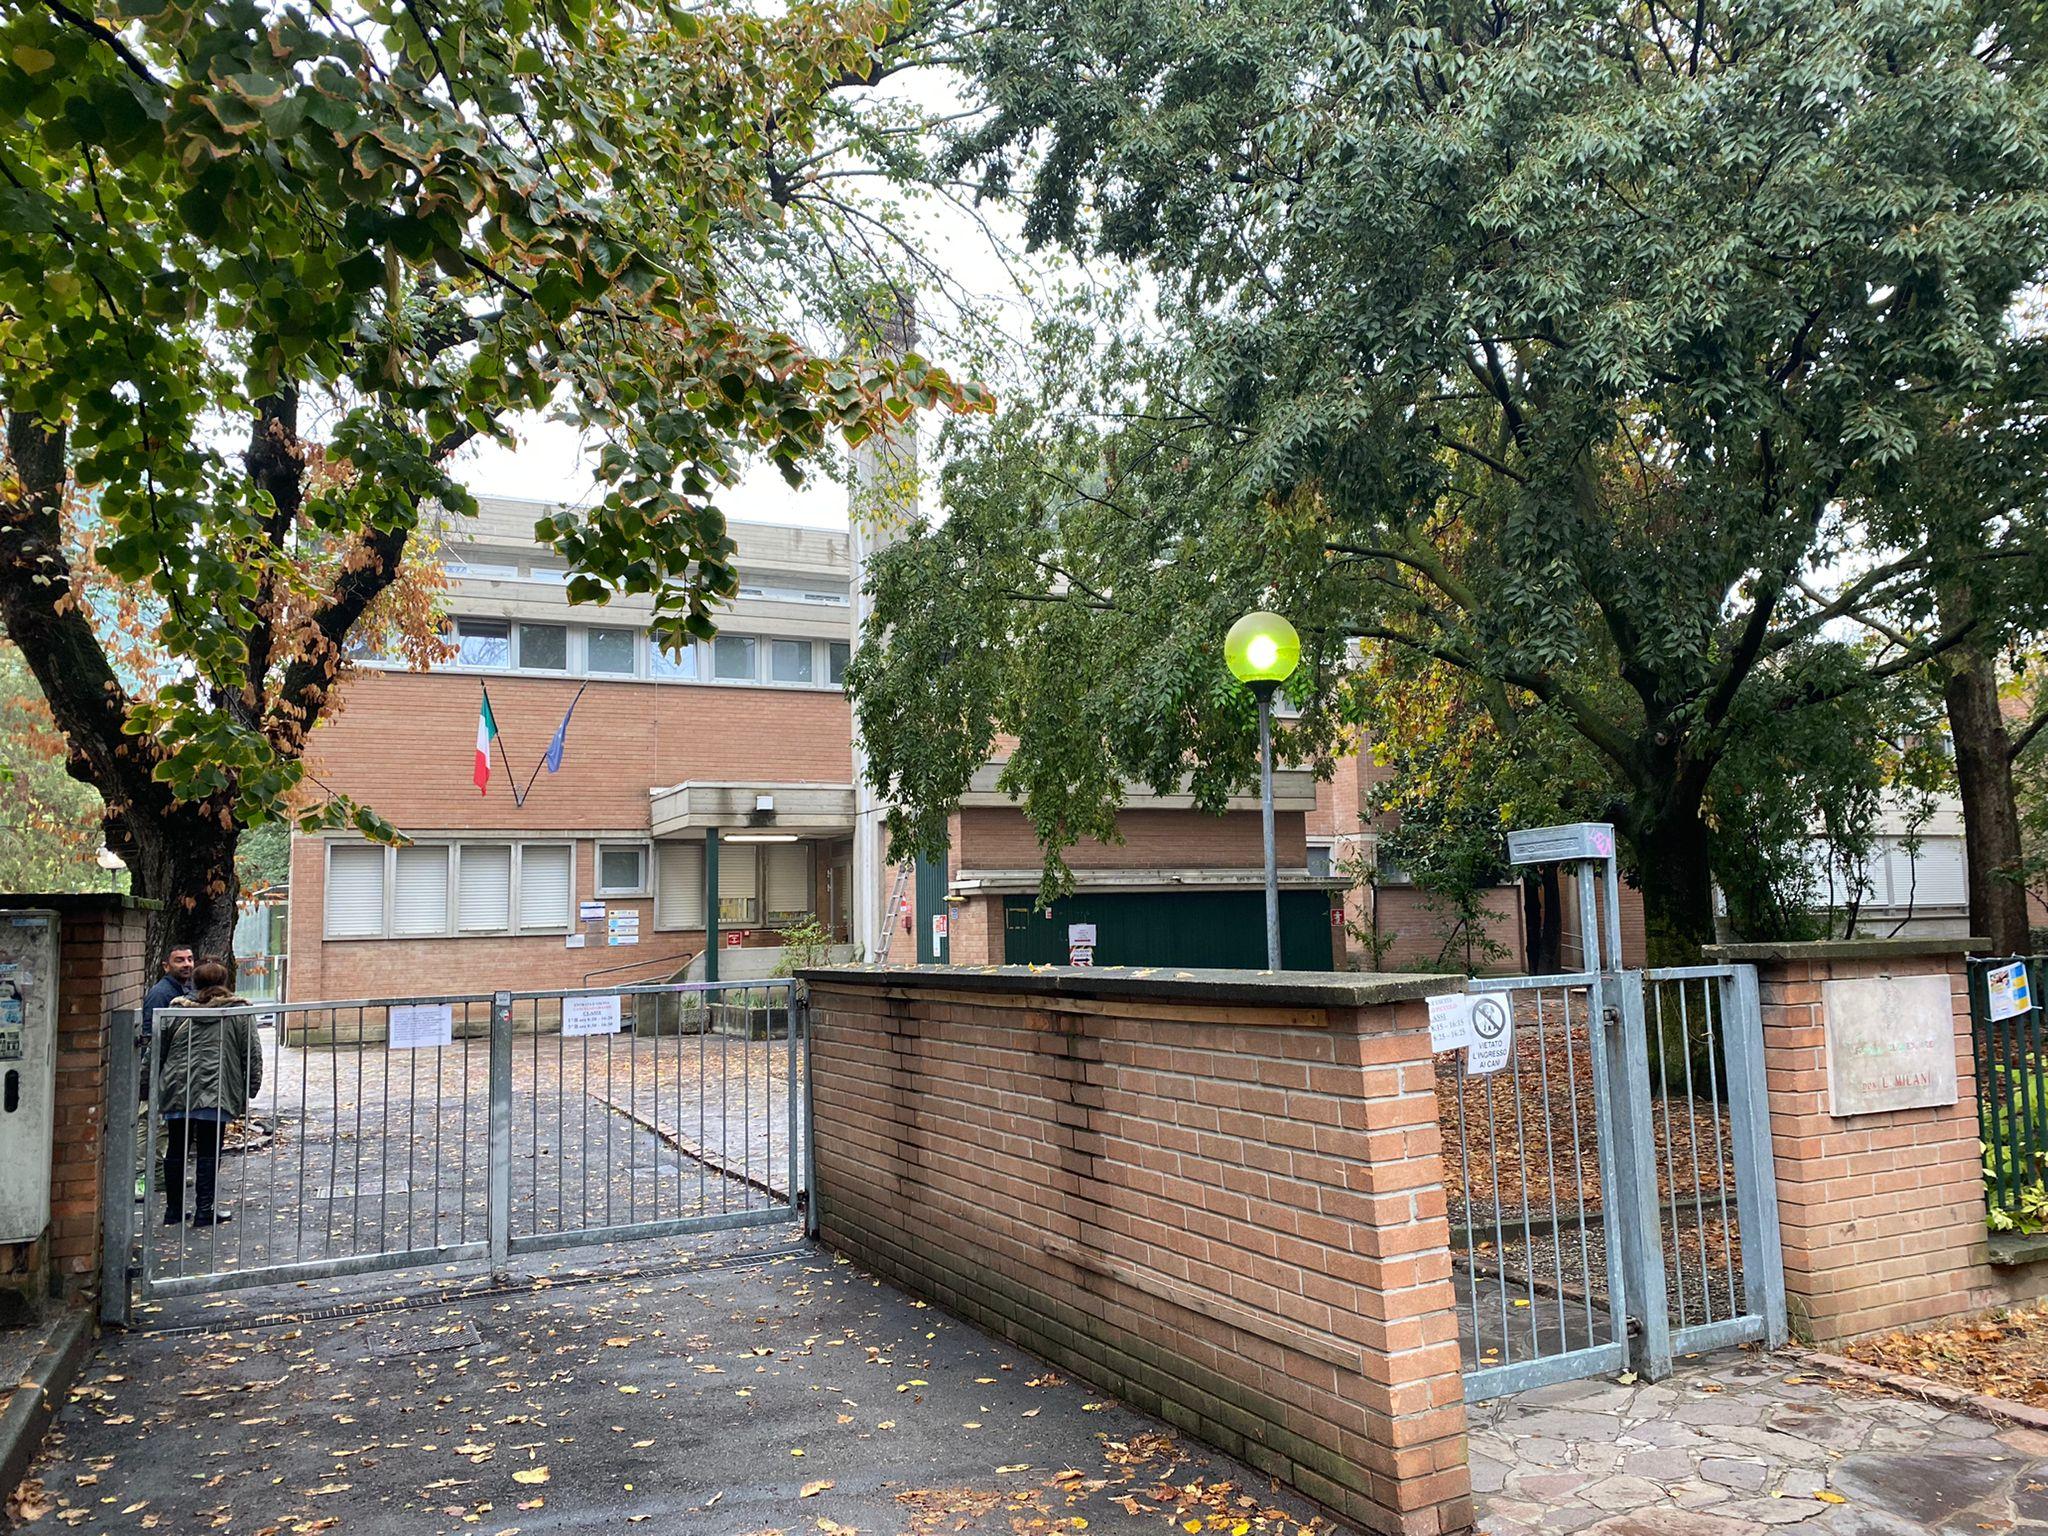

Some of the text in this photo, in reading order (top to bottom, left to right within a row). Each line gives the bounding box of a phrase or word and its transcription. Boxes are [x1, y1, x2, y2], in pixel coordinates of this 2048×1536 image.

[1479, 1040, 1502, 1049] VIETATO
[1473, 1049, 1507, 1059] L'INGRESSO
[1486, 1059, 1501, 1068] CANI
[1895, 1072, 1931, 1087] MILANI
